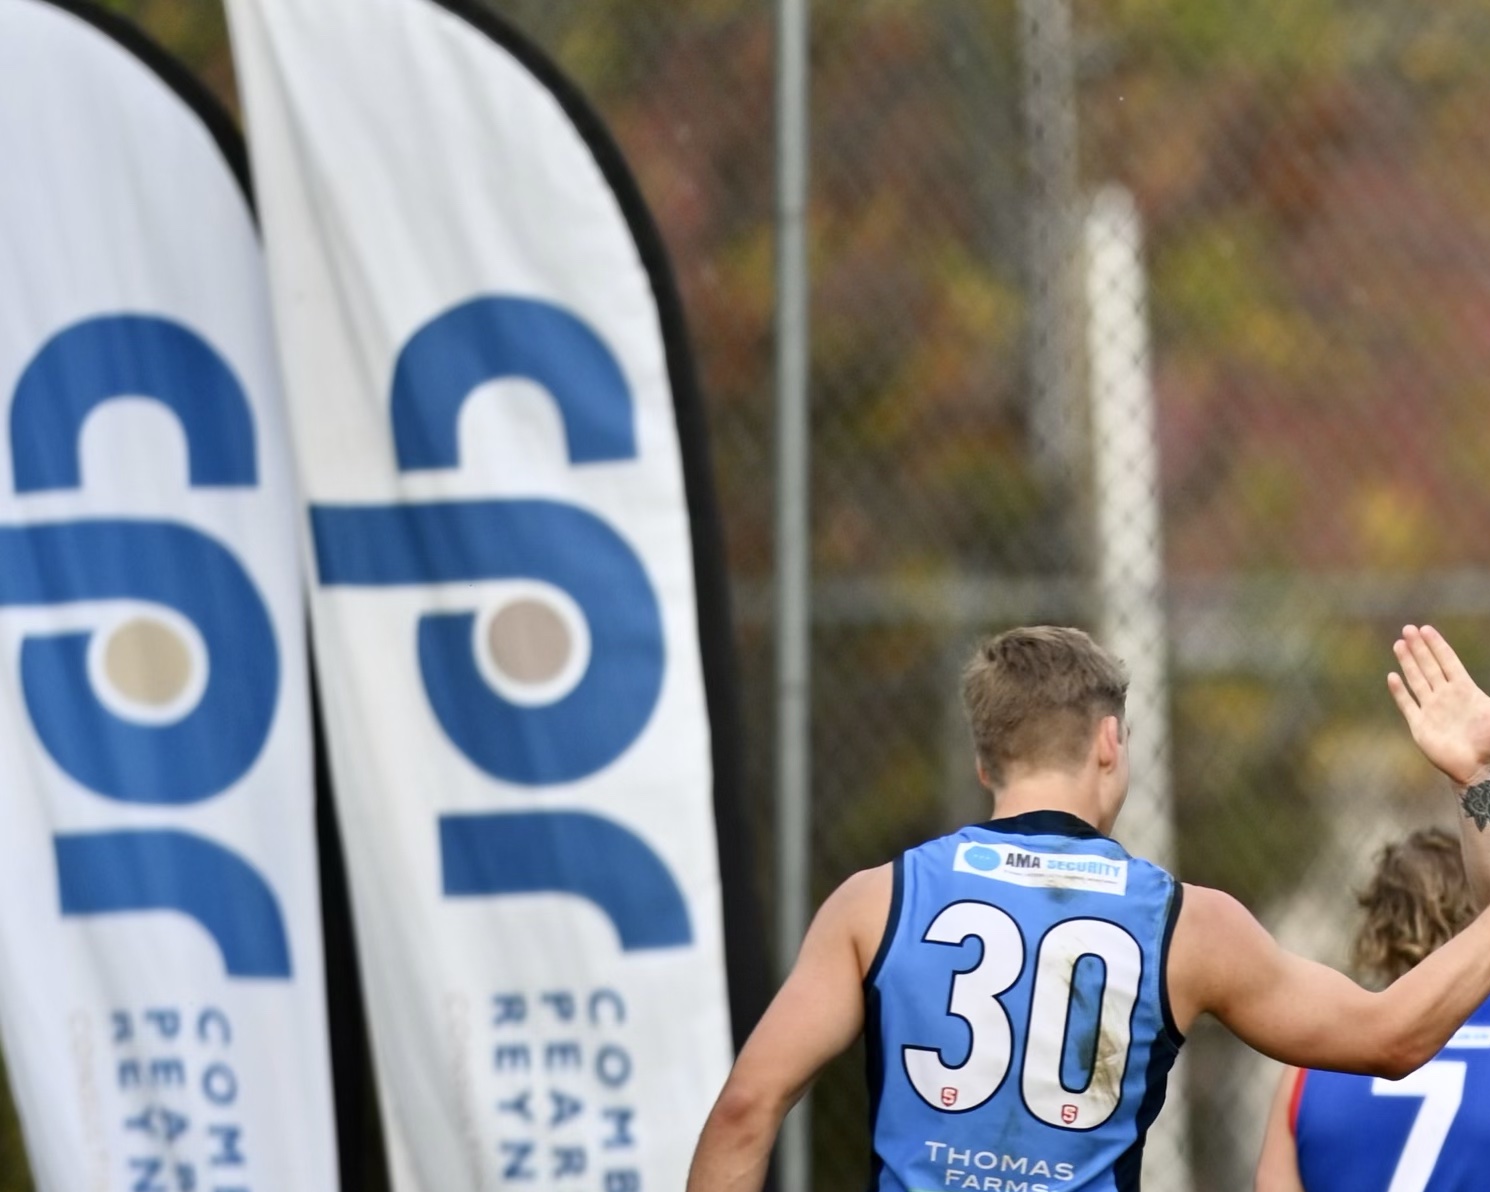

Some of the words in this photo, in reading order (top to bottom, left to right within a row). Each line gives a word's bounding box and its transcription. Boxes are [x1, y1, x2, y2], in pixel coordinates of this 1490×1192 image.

[1006, 853, 1041, 869] AMA
[1047, 859, 1121, 877] SECURITY
[902, 899, 1144, 1132] 30
[925, 1141, 1074, 1181] THOMAS
